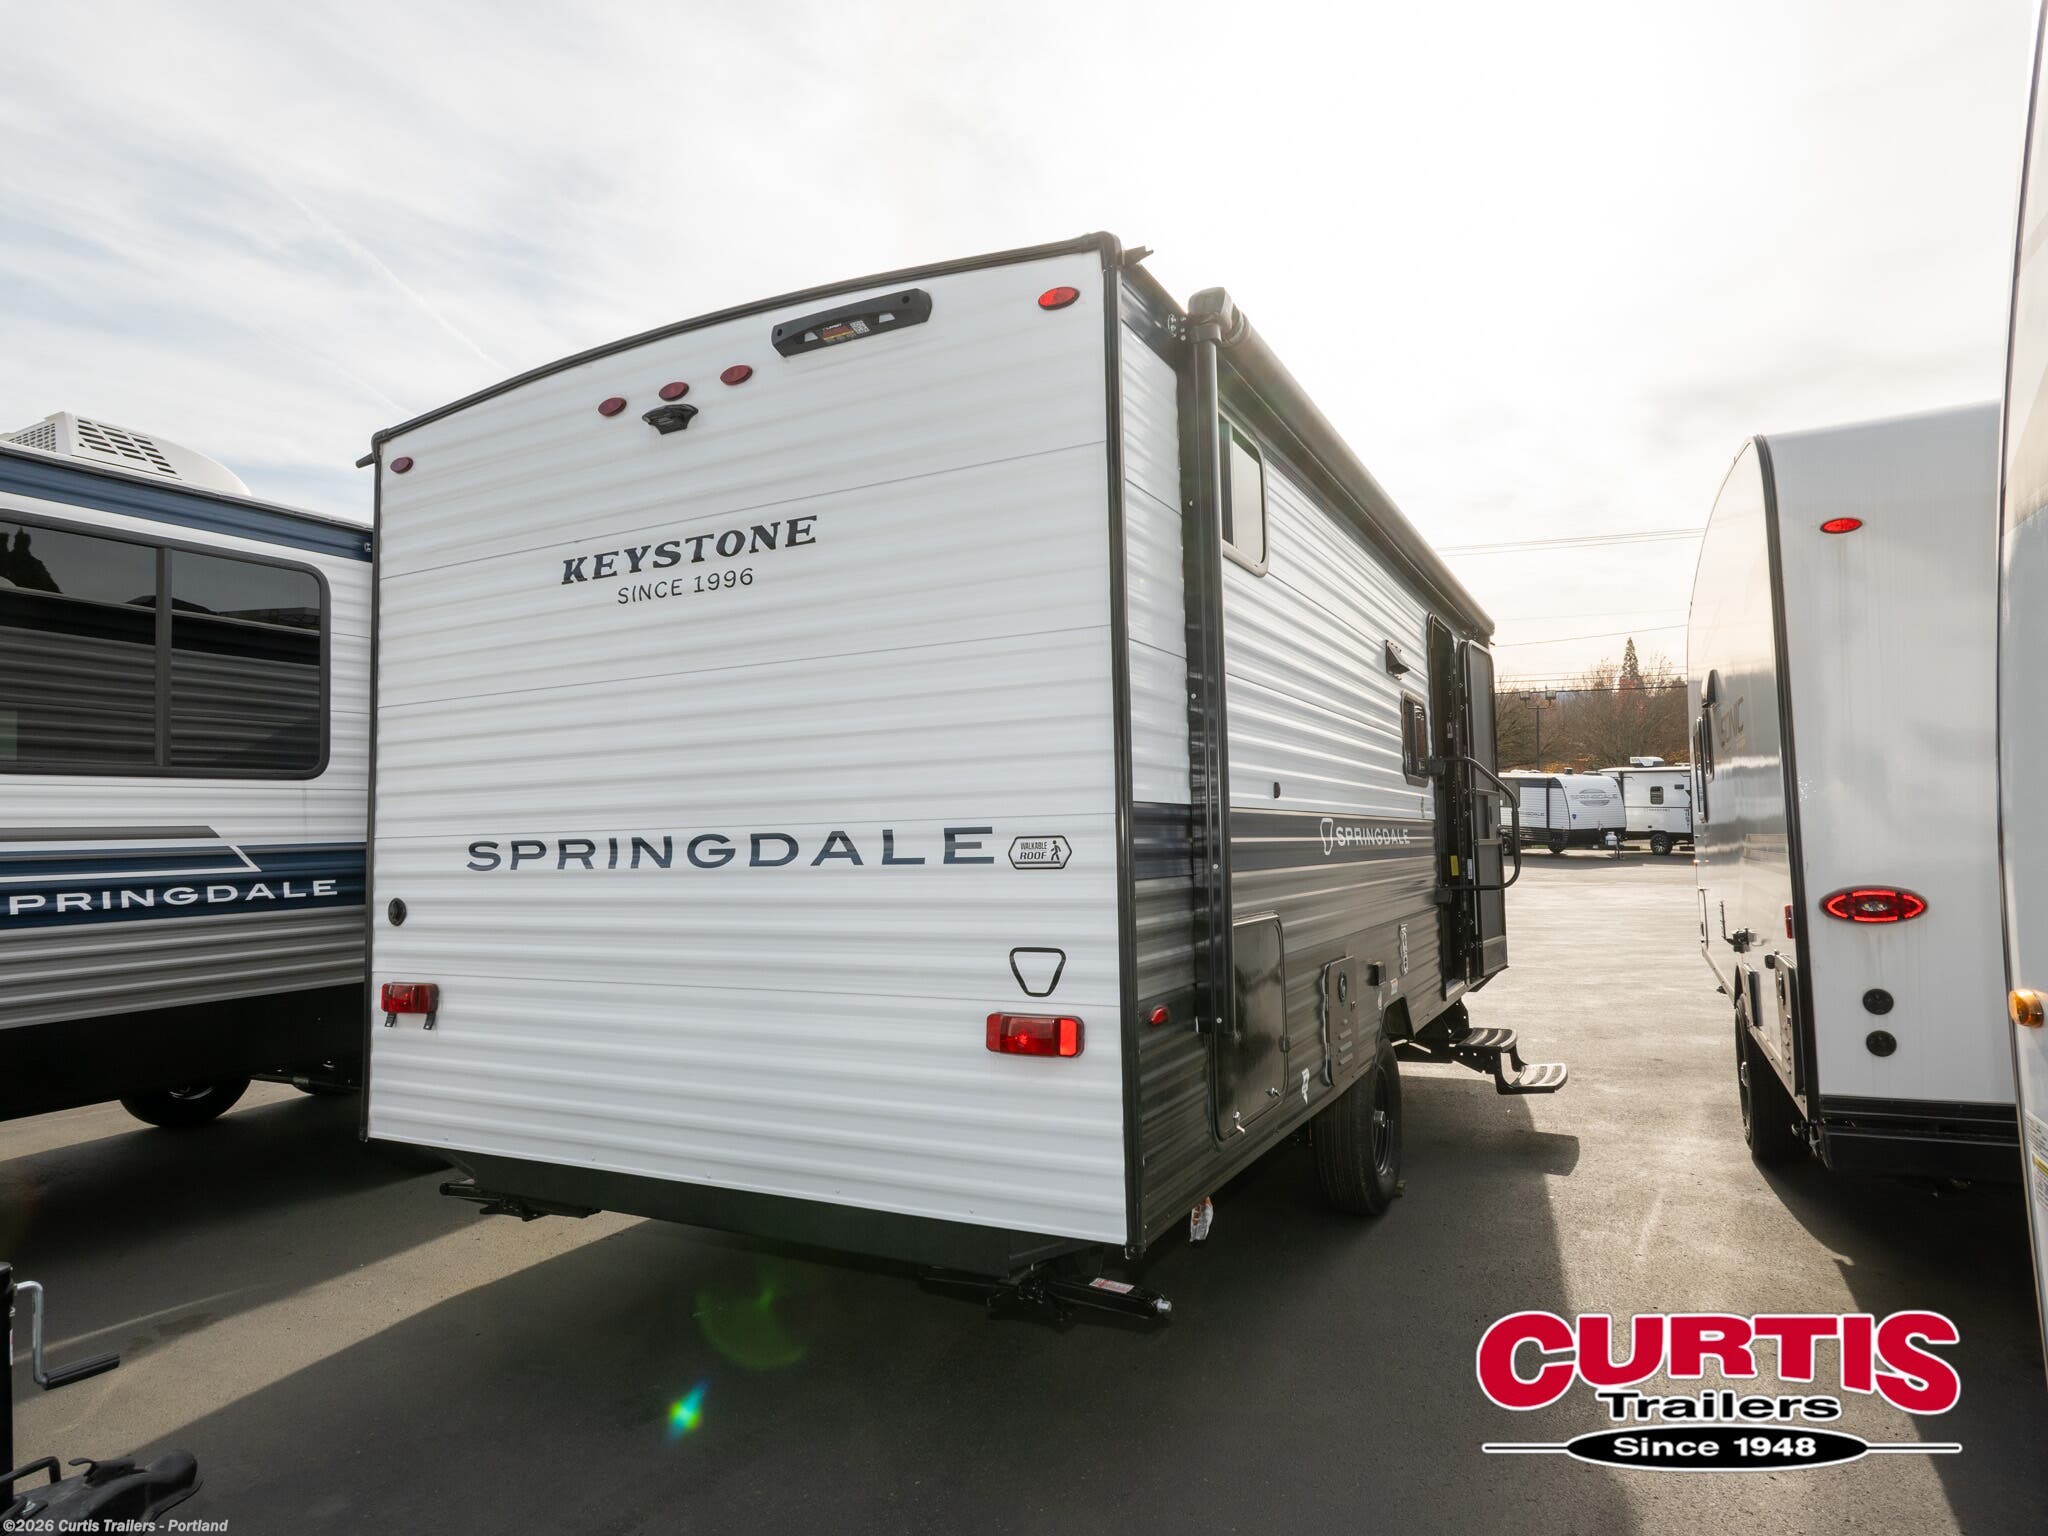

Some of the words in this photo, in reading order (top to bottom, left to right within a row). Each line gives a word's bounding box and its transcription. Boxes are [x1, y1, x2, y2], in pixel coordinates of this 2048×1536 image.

[561, 515, 818, 585] KEYSTONE
[617, 578, 683, 605] SINCE
[694, 567, 754, 593] 1996
[466, 826, 996, 872] SPRINGDALE
[1020, 841, 1048, 850] WALKABLE
[1335, 826, 1411, 847] SPRINGDALE
[1019, 851, 1048, 860] ROOF
